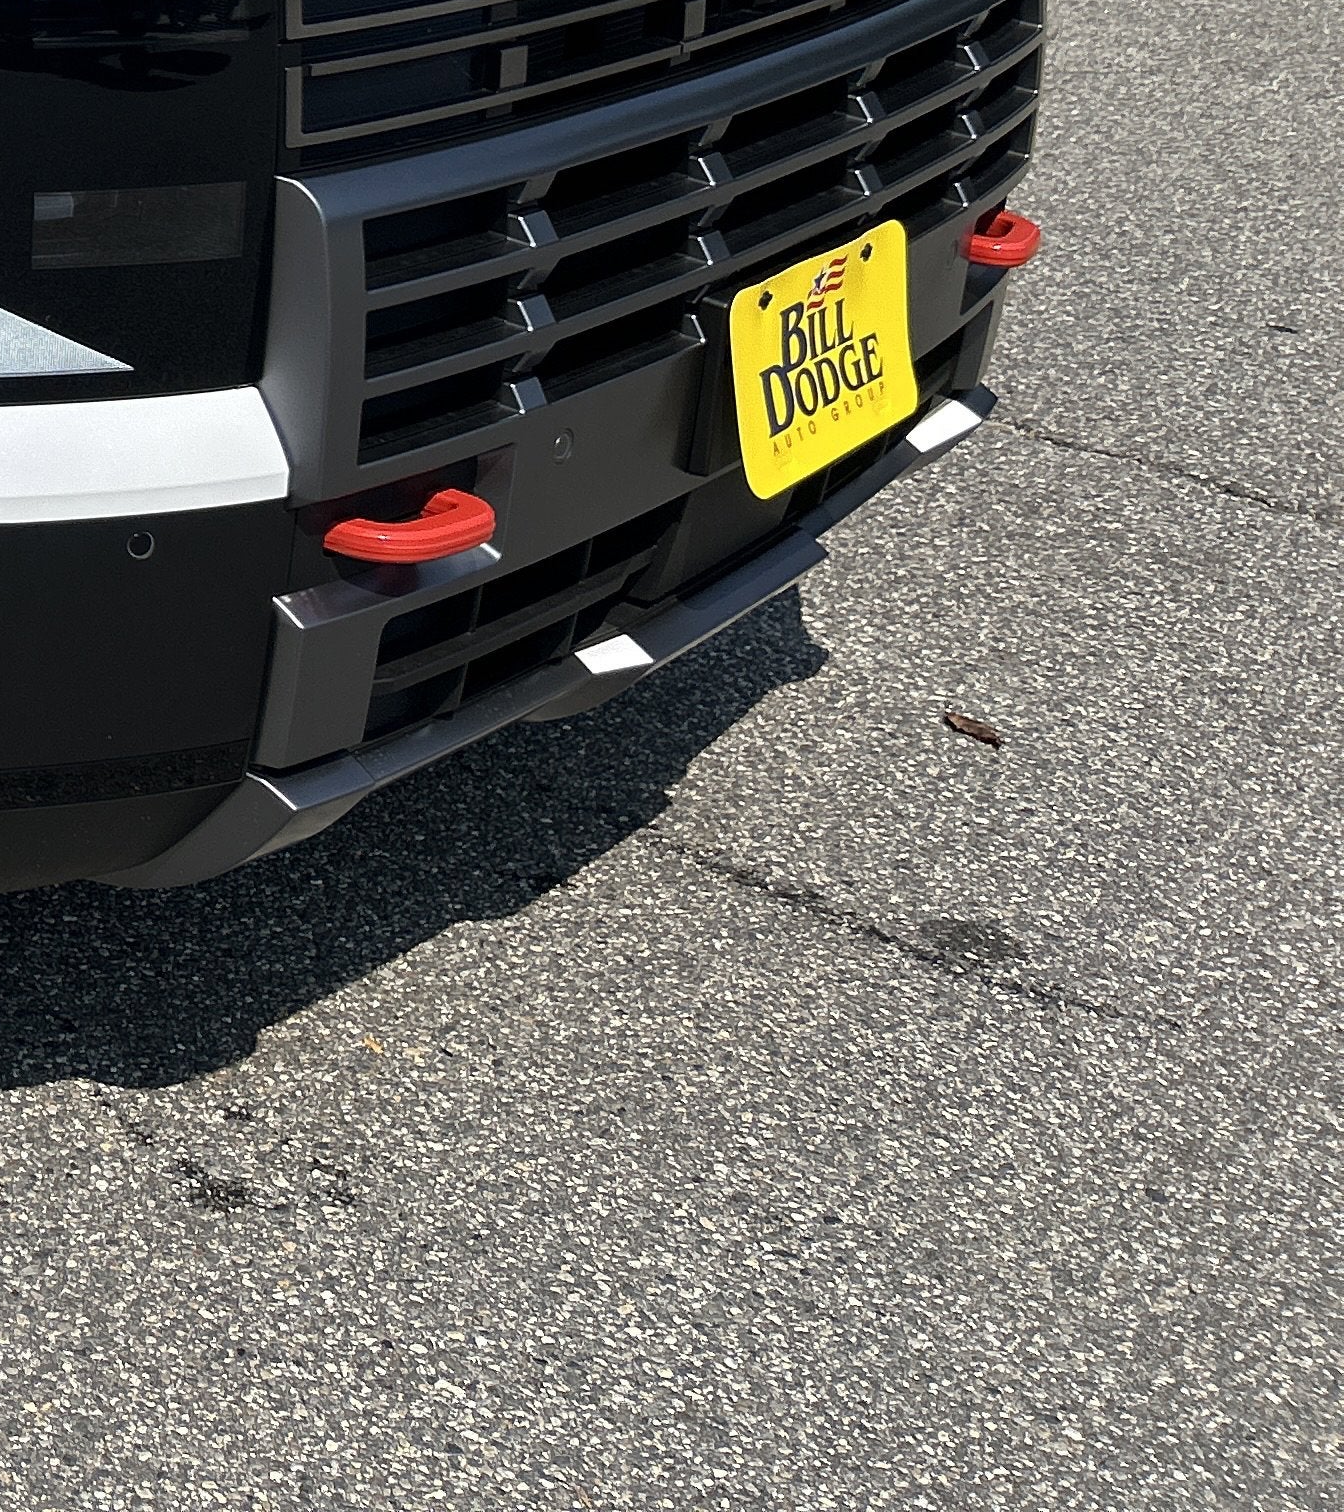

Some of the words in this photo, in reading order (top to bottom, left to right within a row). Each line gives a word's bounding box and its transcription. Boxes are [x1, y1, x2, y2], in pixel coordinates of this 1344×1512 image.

[779, 297, 854, 376] BILL
[759, 332, 884, 439] DODGE
[772, 421, 817, 457] AUTO
[831, 380, 887, 423] GROUP
